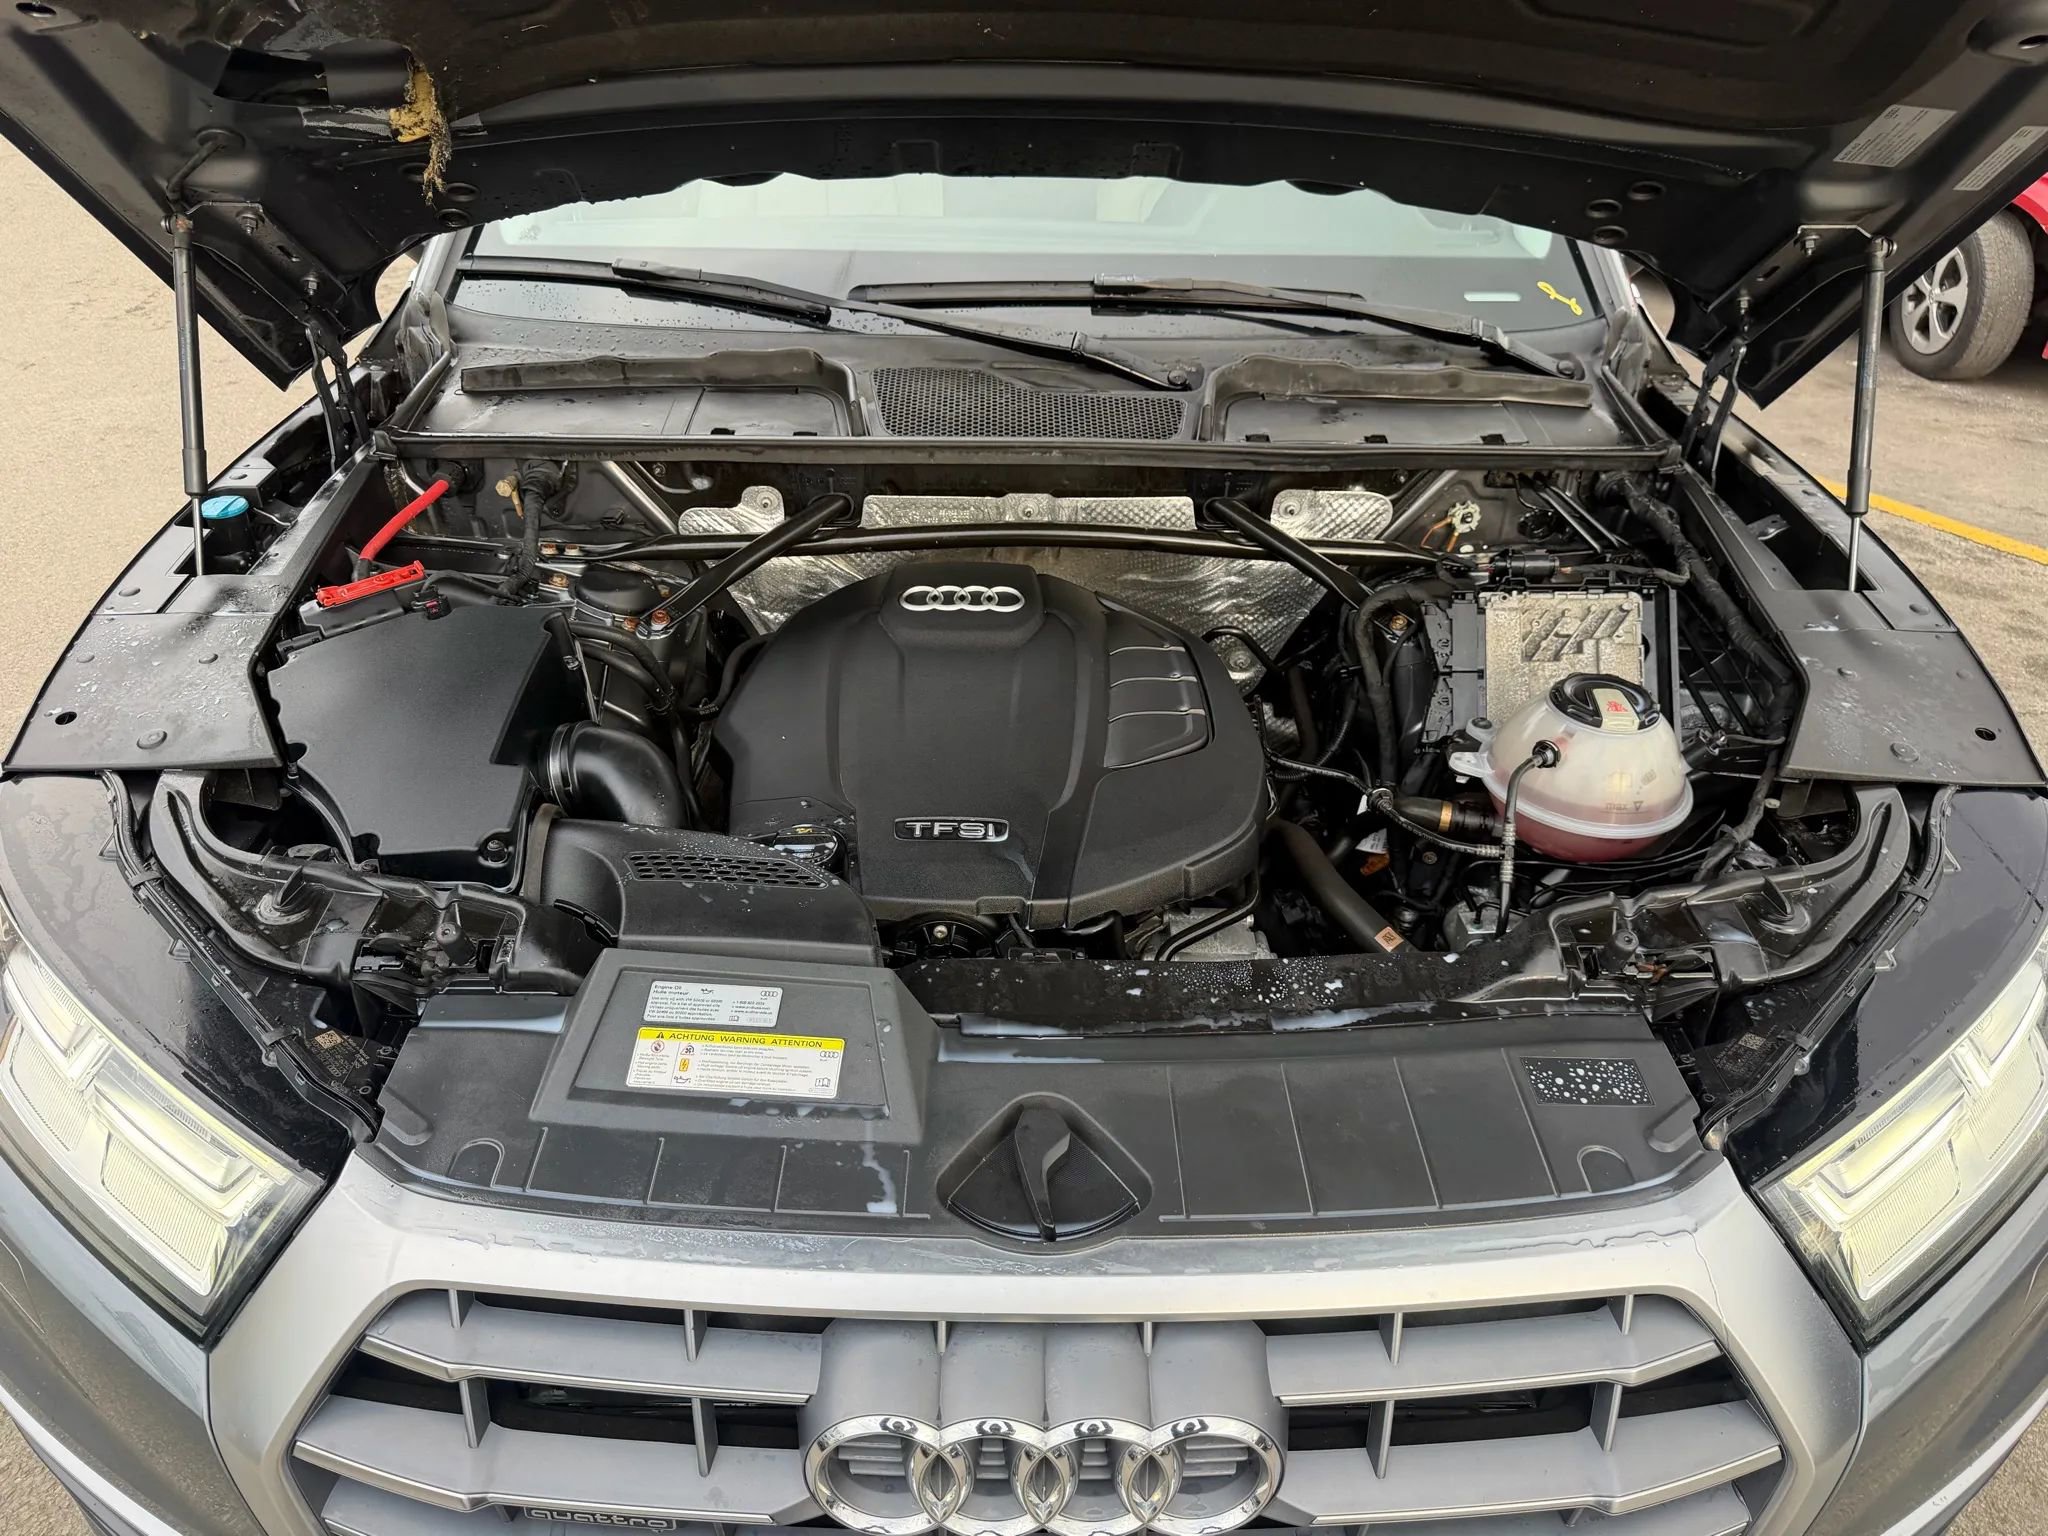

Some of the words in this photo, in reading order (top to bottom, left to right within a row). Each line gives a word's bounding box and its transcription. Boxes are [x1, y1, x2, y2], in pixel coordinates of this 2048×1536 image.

[905, 822, 996, 839] TFSI
[669, 1032, 715, 1042] ACHTUNG
[720, 1035, 766, 1045] WARNING
[771, 1039, 823, 1048] ATTENTION
[531, 1509, 668, 1528] quattro
